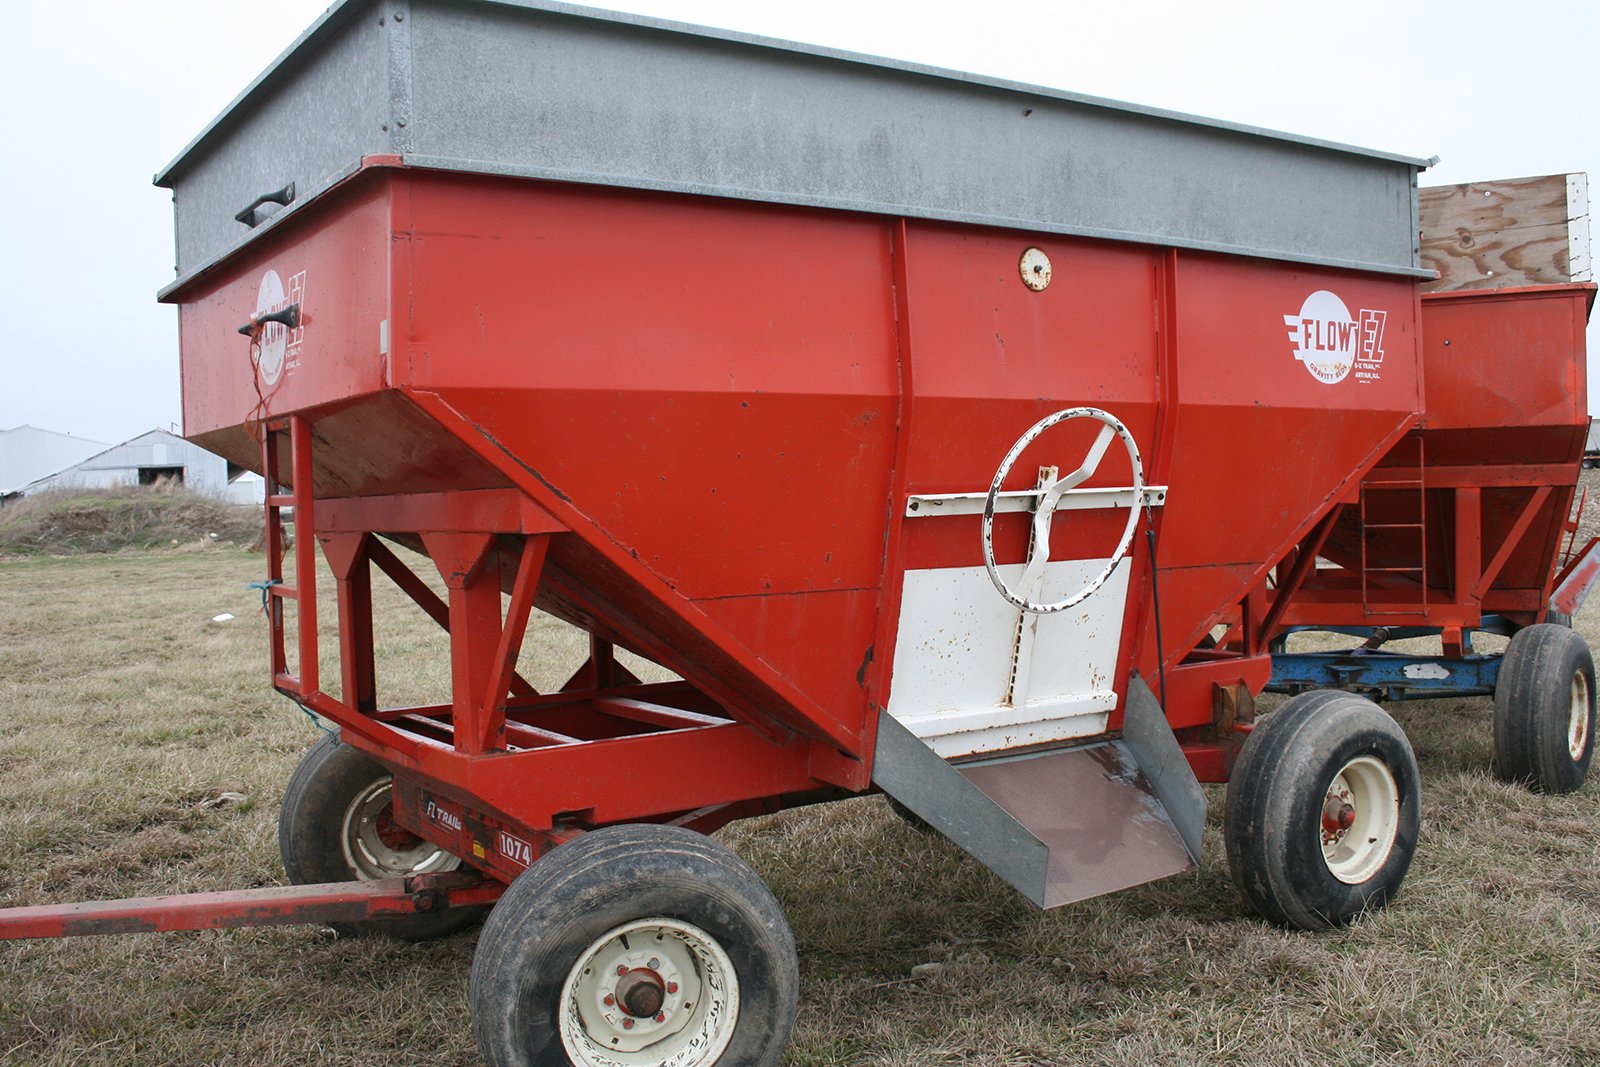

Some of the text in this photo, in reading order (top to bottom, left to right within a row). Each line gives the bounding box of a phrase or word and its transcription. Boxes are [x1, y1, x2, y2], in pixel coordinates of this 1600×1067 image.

[1301, 308, 1387, 362] FLOW EZ
[1309, 362, 1348, 380] GRAVITY BEDS
[501, 834, 531, 866] 1074
